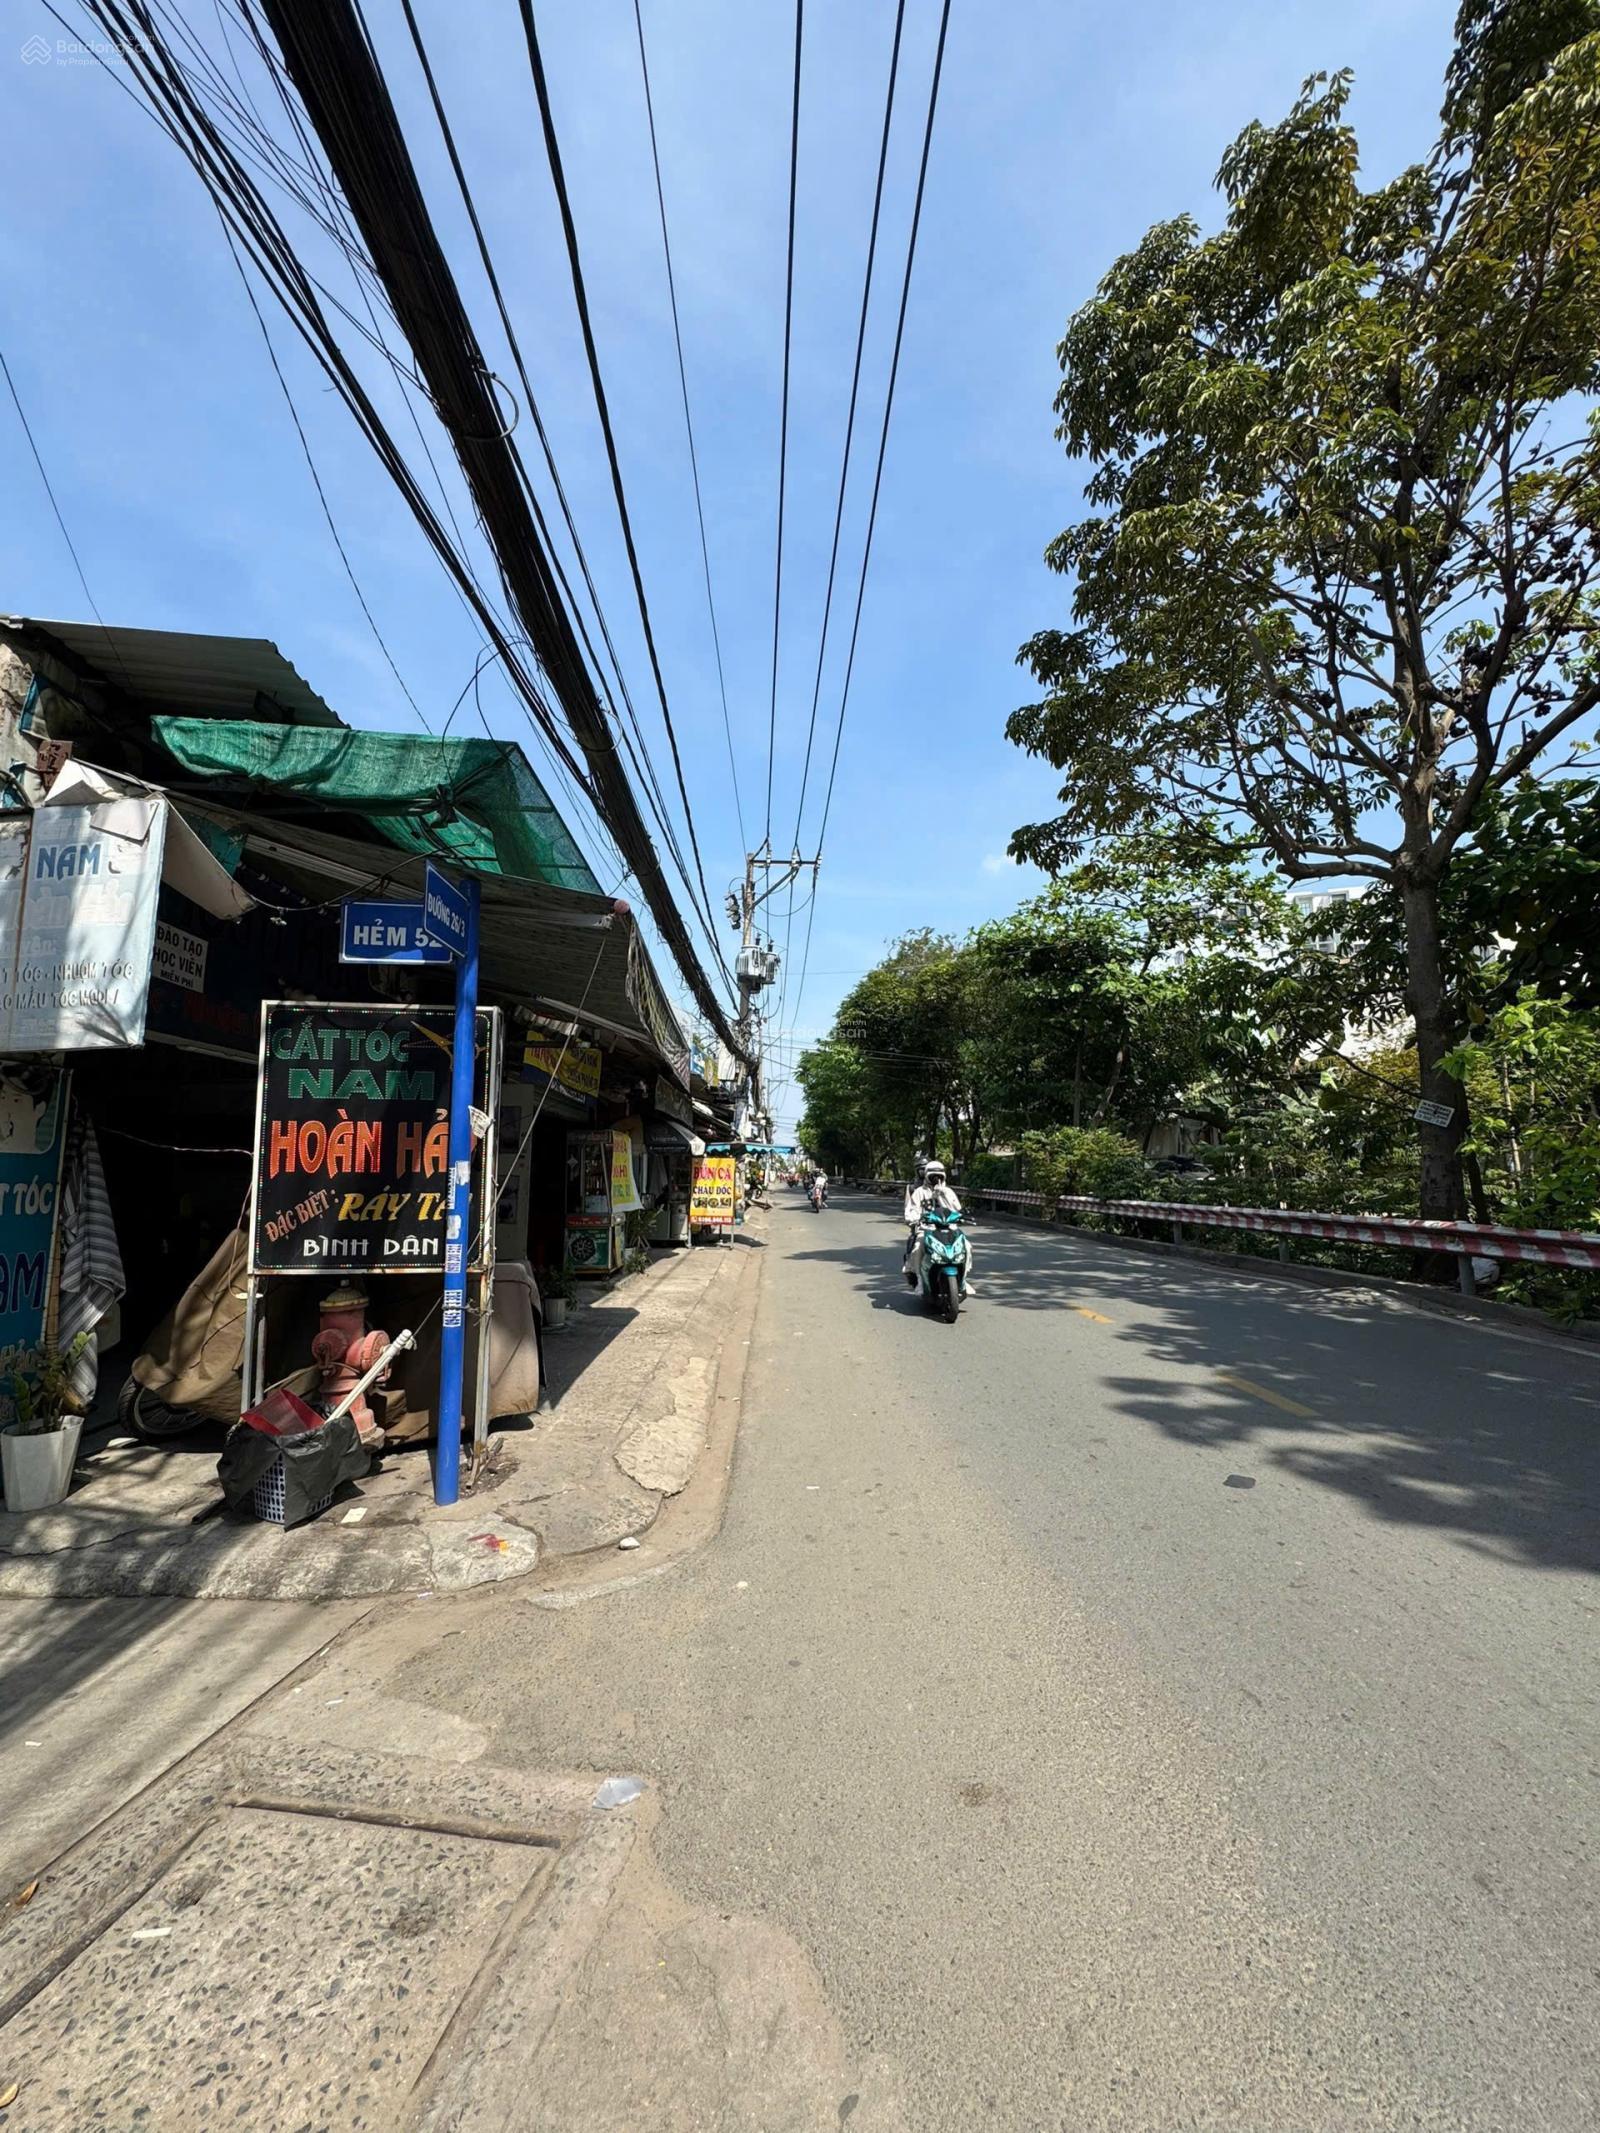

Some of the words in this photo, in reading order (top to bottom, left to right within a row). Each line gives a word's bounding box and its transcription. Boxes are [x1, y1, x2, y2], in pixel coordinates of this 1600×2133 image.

[36, 843, 102, 880] NAM
[354, 918, 406, 947] HẺM
[451, 912, 465, 937] 26/3
[153, 945, 176, 967] HỌC
[183, 936, 203, 957] TẠO
[271, 1016, 340, 1061] CẮT
[345, 1023, 410, 1062] TÓC
[288, 1069, 435, 1101] NAM
[269, 1109, 383, 1179] HOÀN
[396, 1108, 450, 1179] HẢ
[13, 1174, 54, 1216] TÓC
[264, 1209, 298, 1243] ĐẶC
[338, 1186, 412, 1222] RÁY
[303, 1235, 370, 1257] BÌNH
[383, 1235, 440, 1256] DÂN
